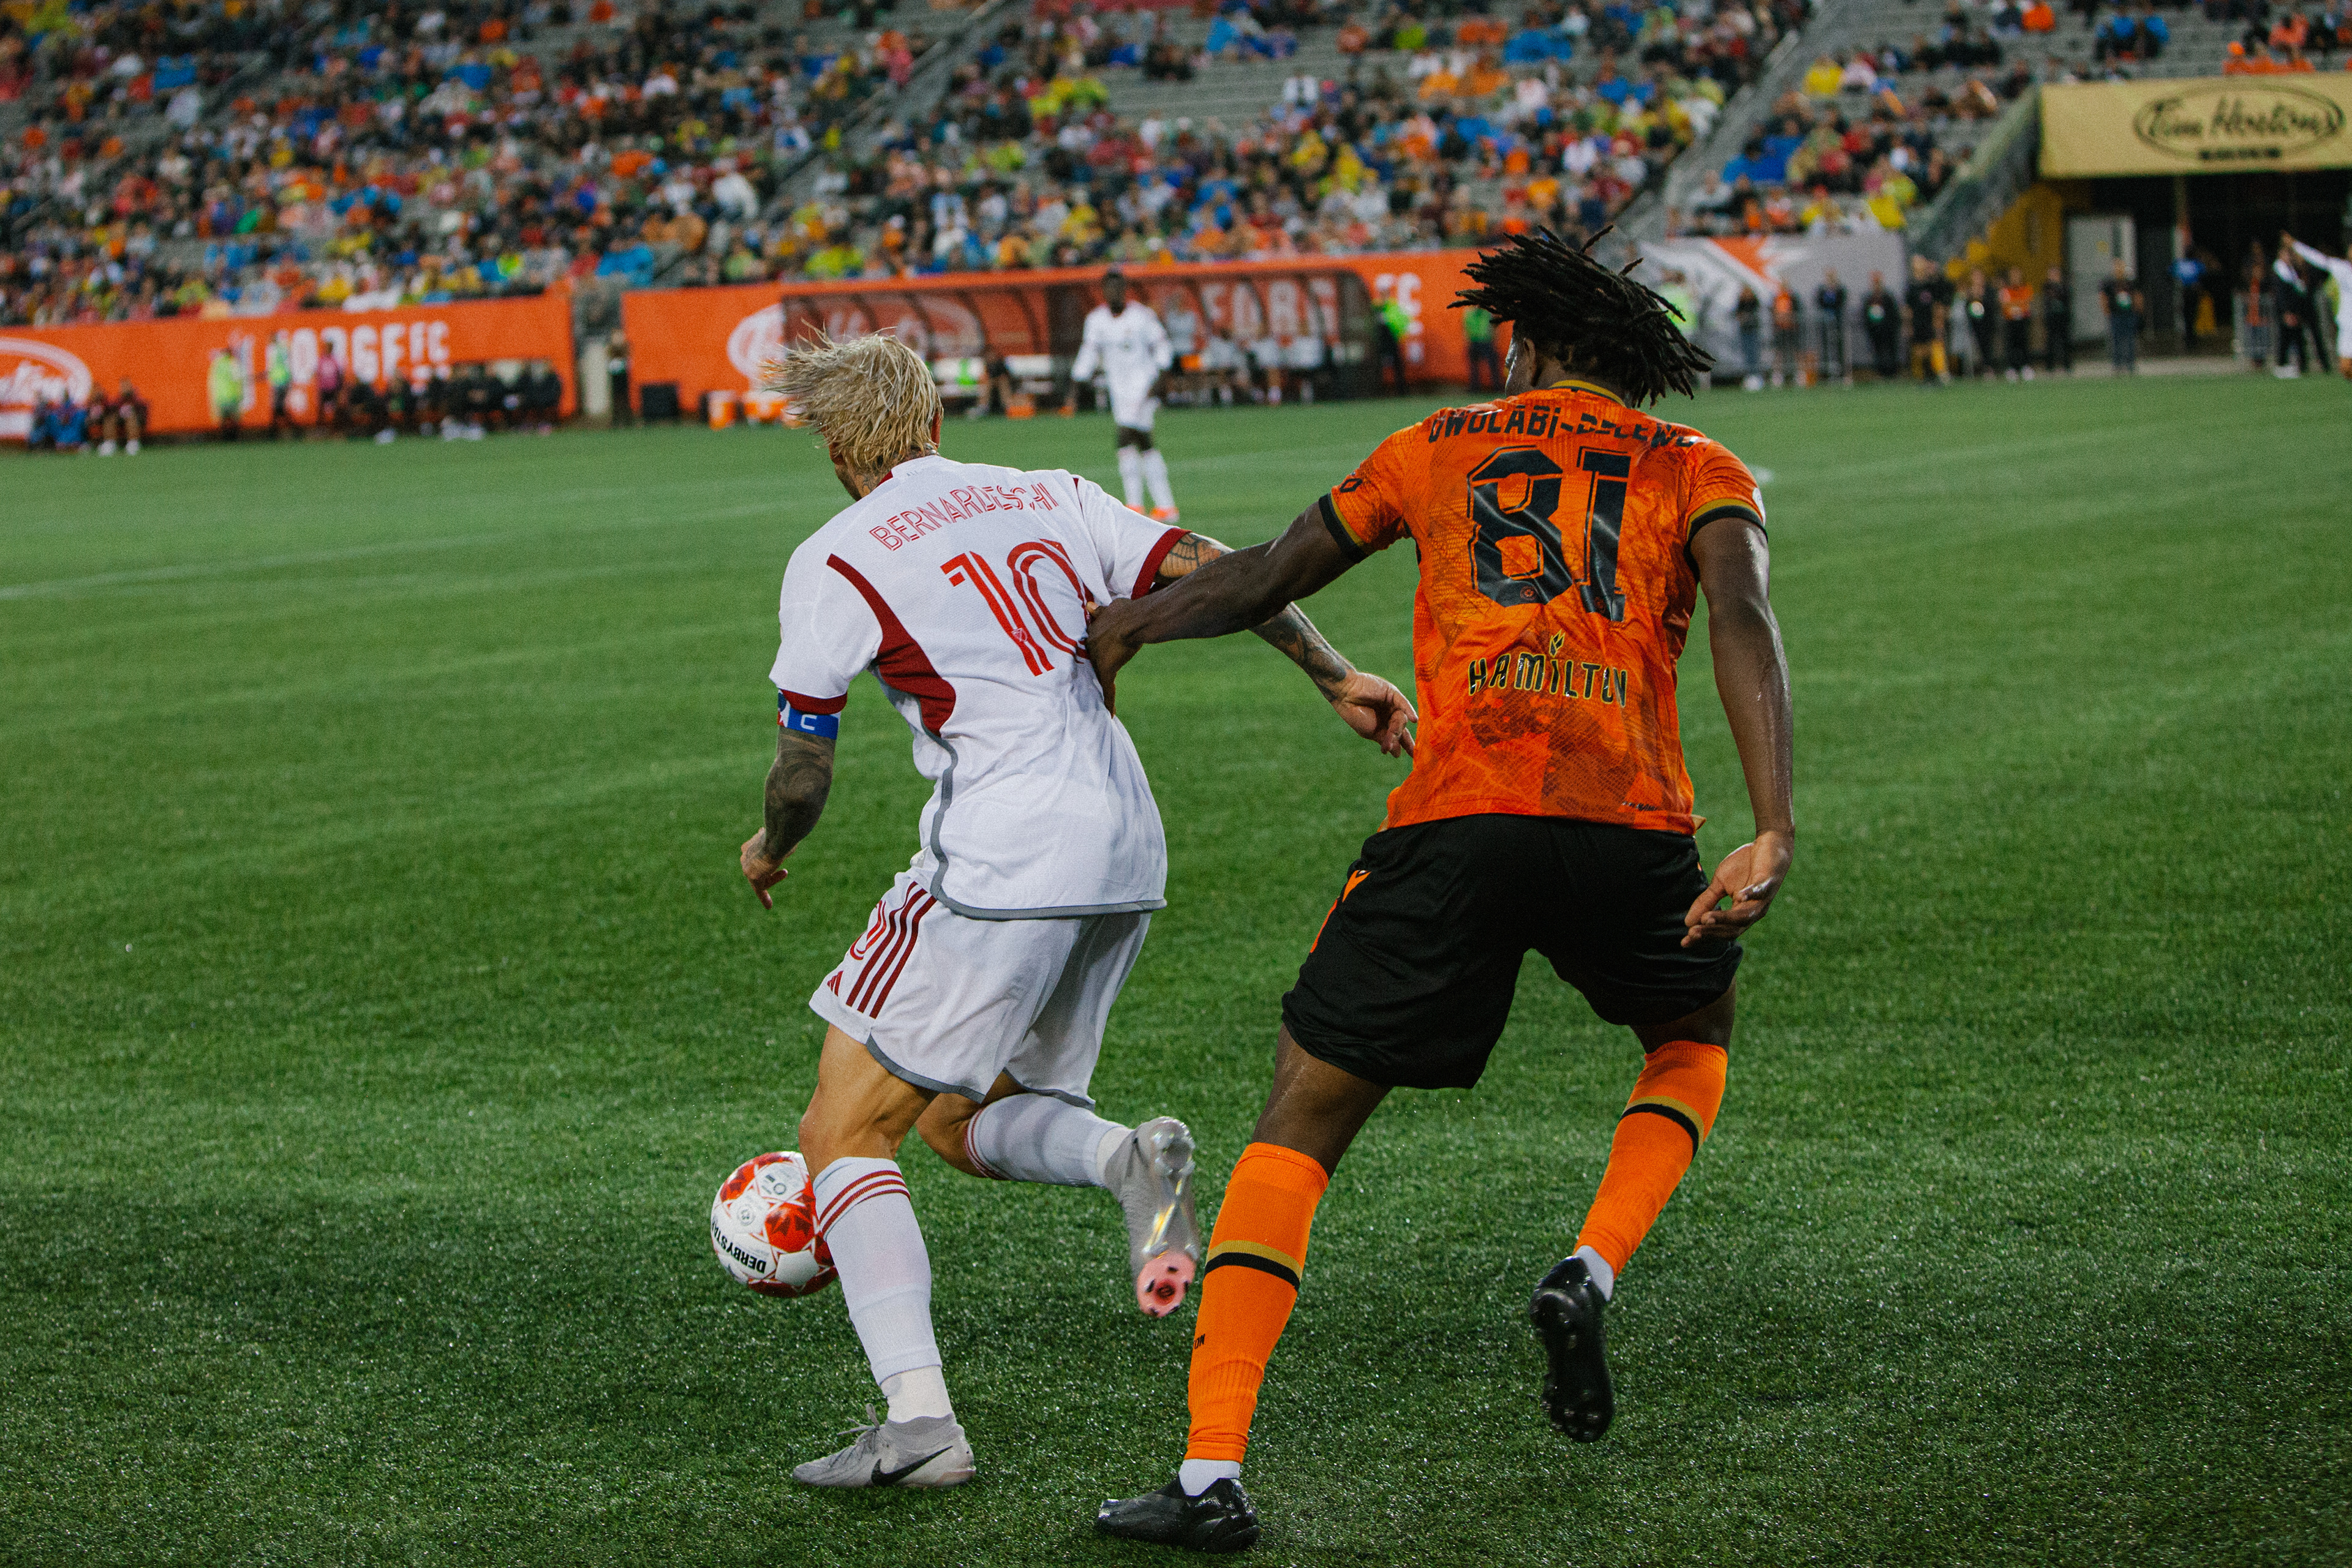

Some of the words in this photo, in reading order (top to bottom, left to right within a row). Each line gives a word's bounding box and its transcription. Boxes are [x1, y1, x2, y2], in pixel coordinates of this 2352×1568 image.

[1466, 445, 1632, 622] 81
[940, 538, 1095, 677] 10
[800, 714, 818, 731] C
